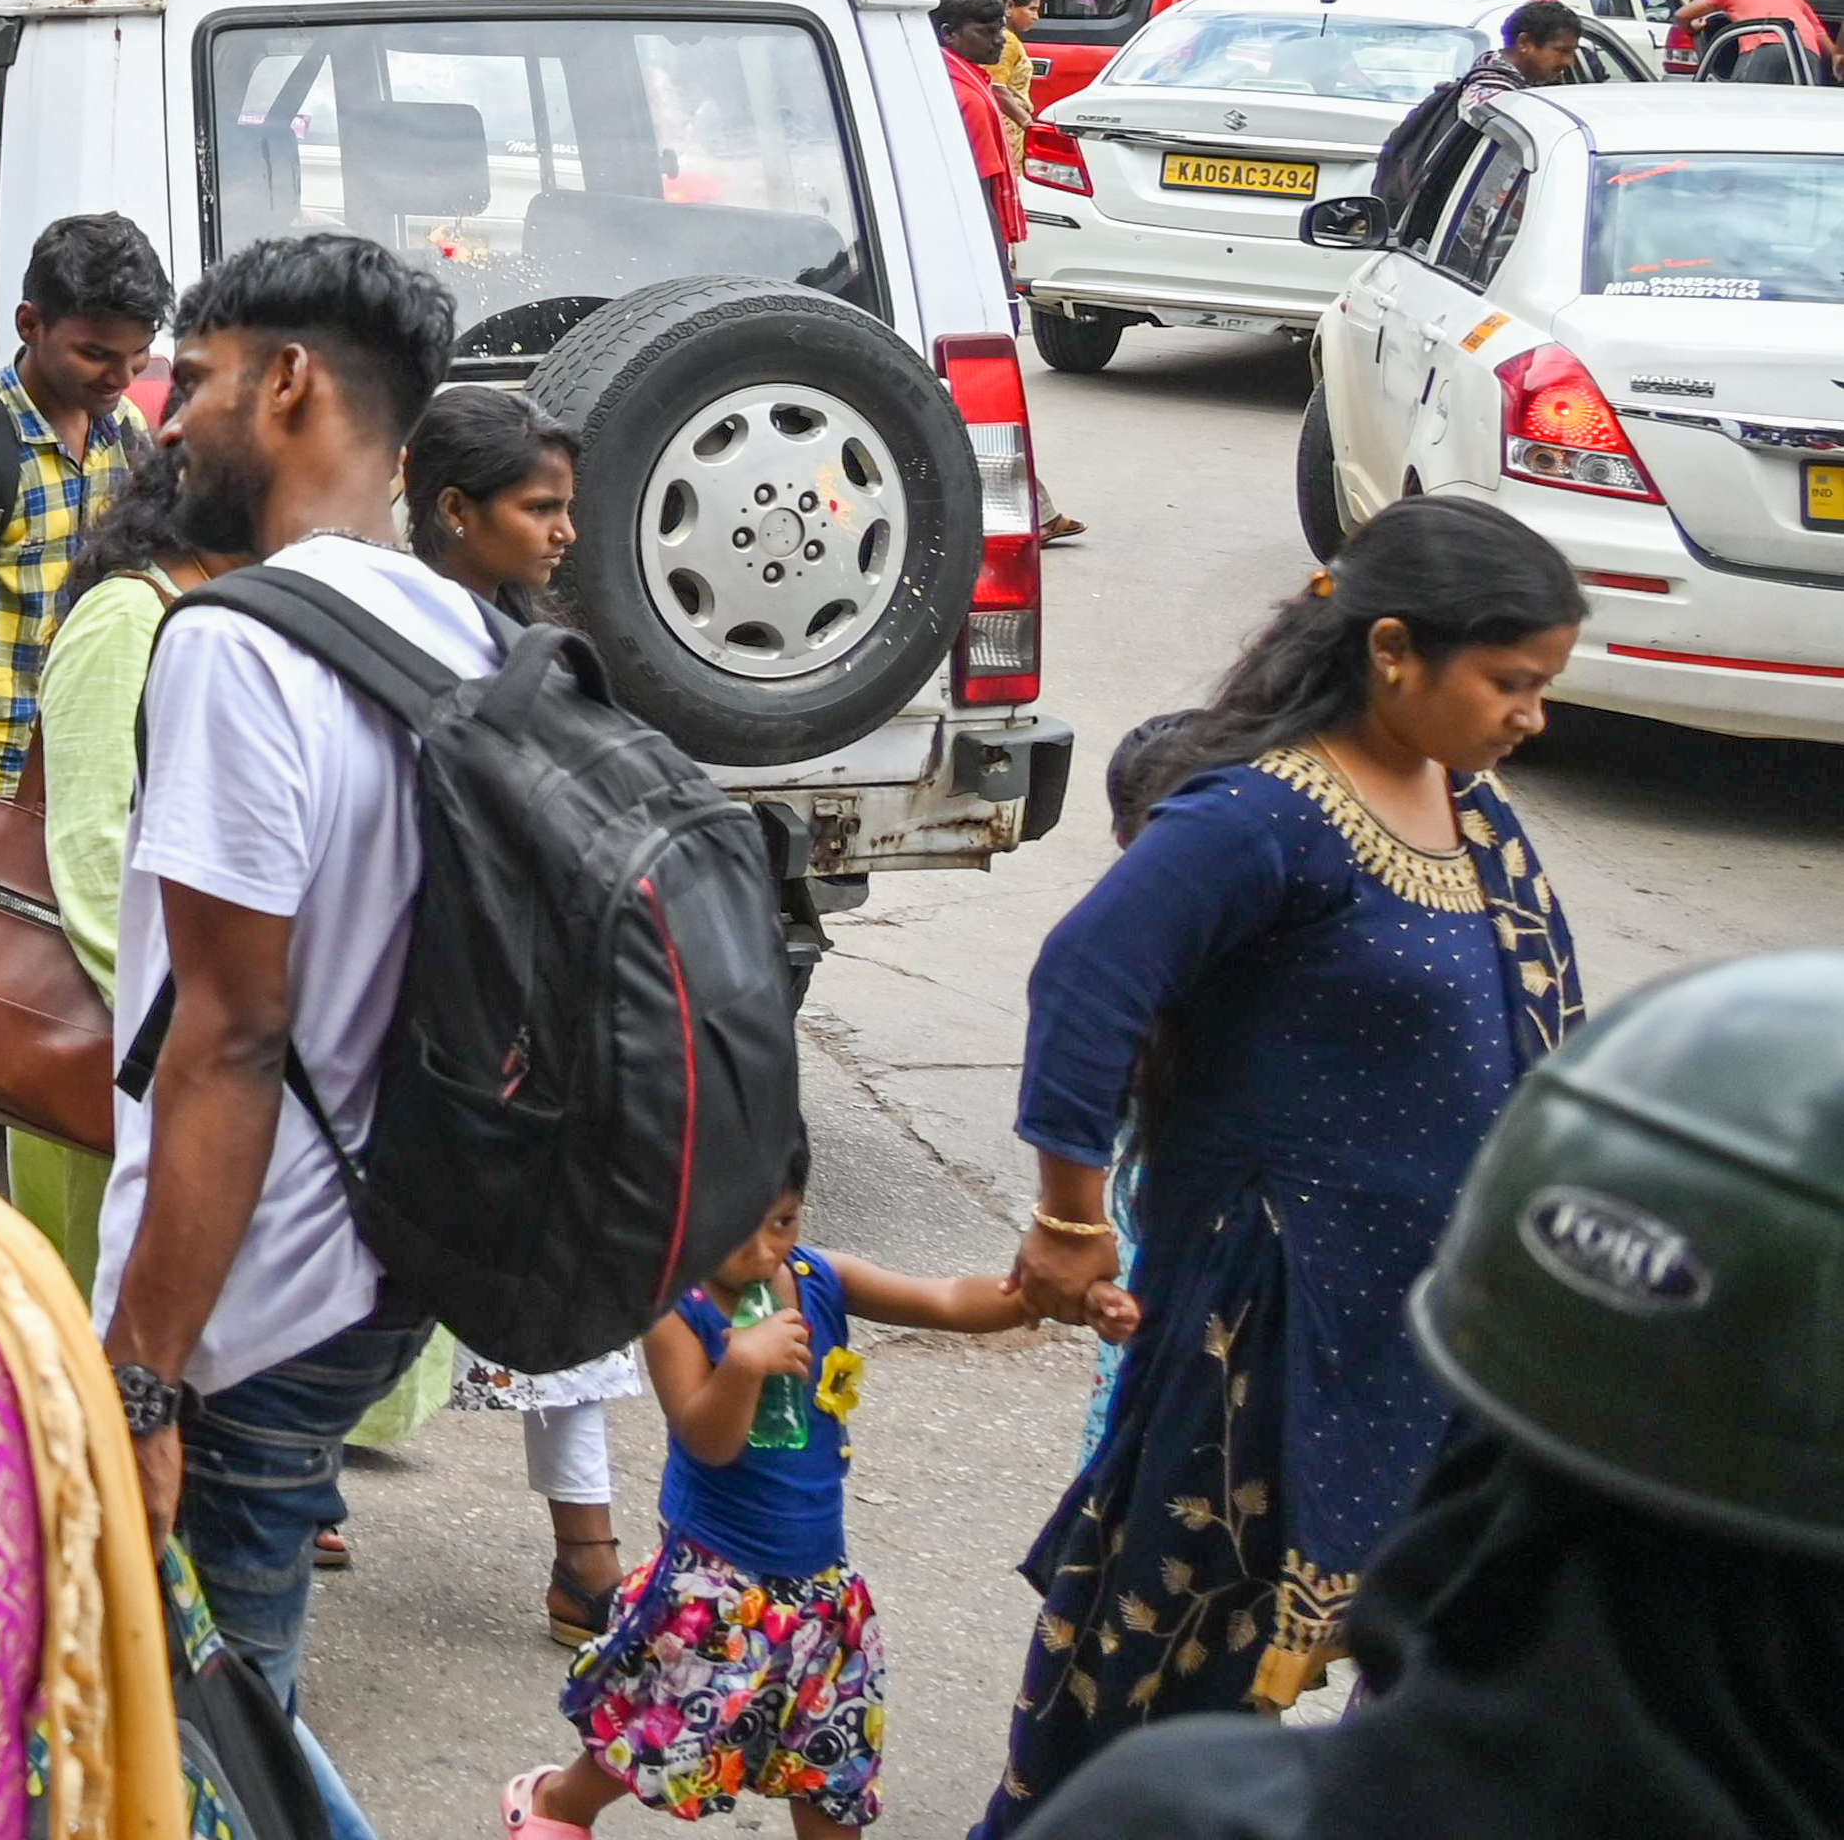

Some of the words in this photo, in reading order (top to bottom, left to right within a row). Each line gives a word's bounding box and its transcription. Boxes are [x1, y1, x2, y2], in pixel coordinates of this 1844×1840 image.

[1176, 161, 1312, 191] KA06AC3494
[1604, 281, 1650, 296] MOB:
[1649, 276, 1760, 289] 9448544773
[1650, 287, 1760, 299] 9902874164
[1630, 373, 1715, 387] MARUTI
